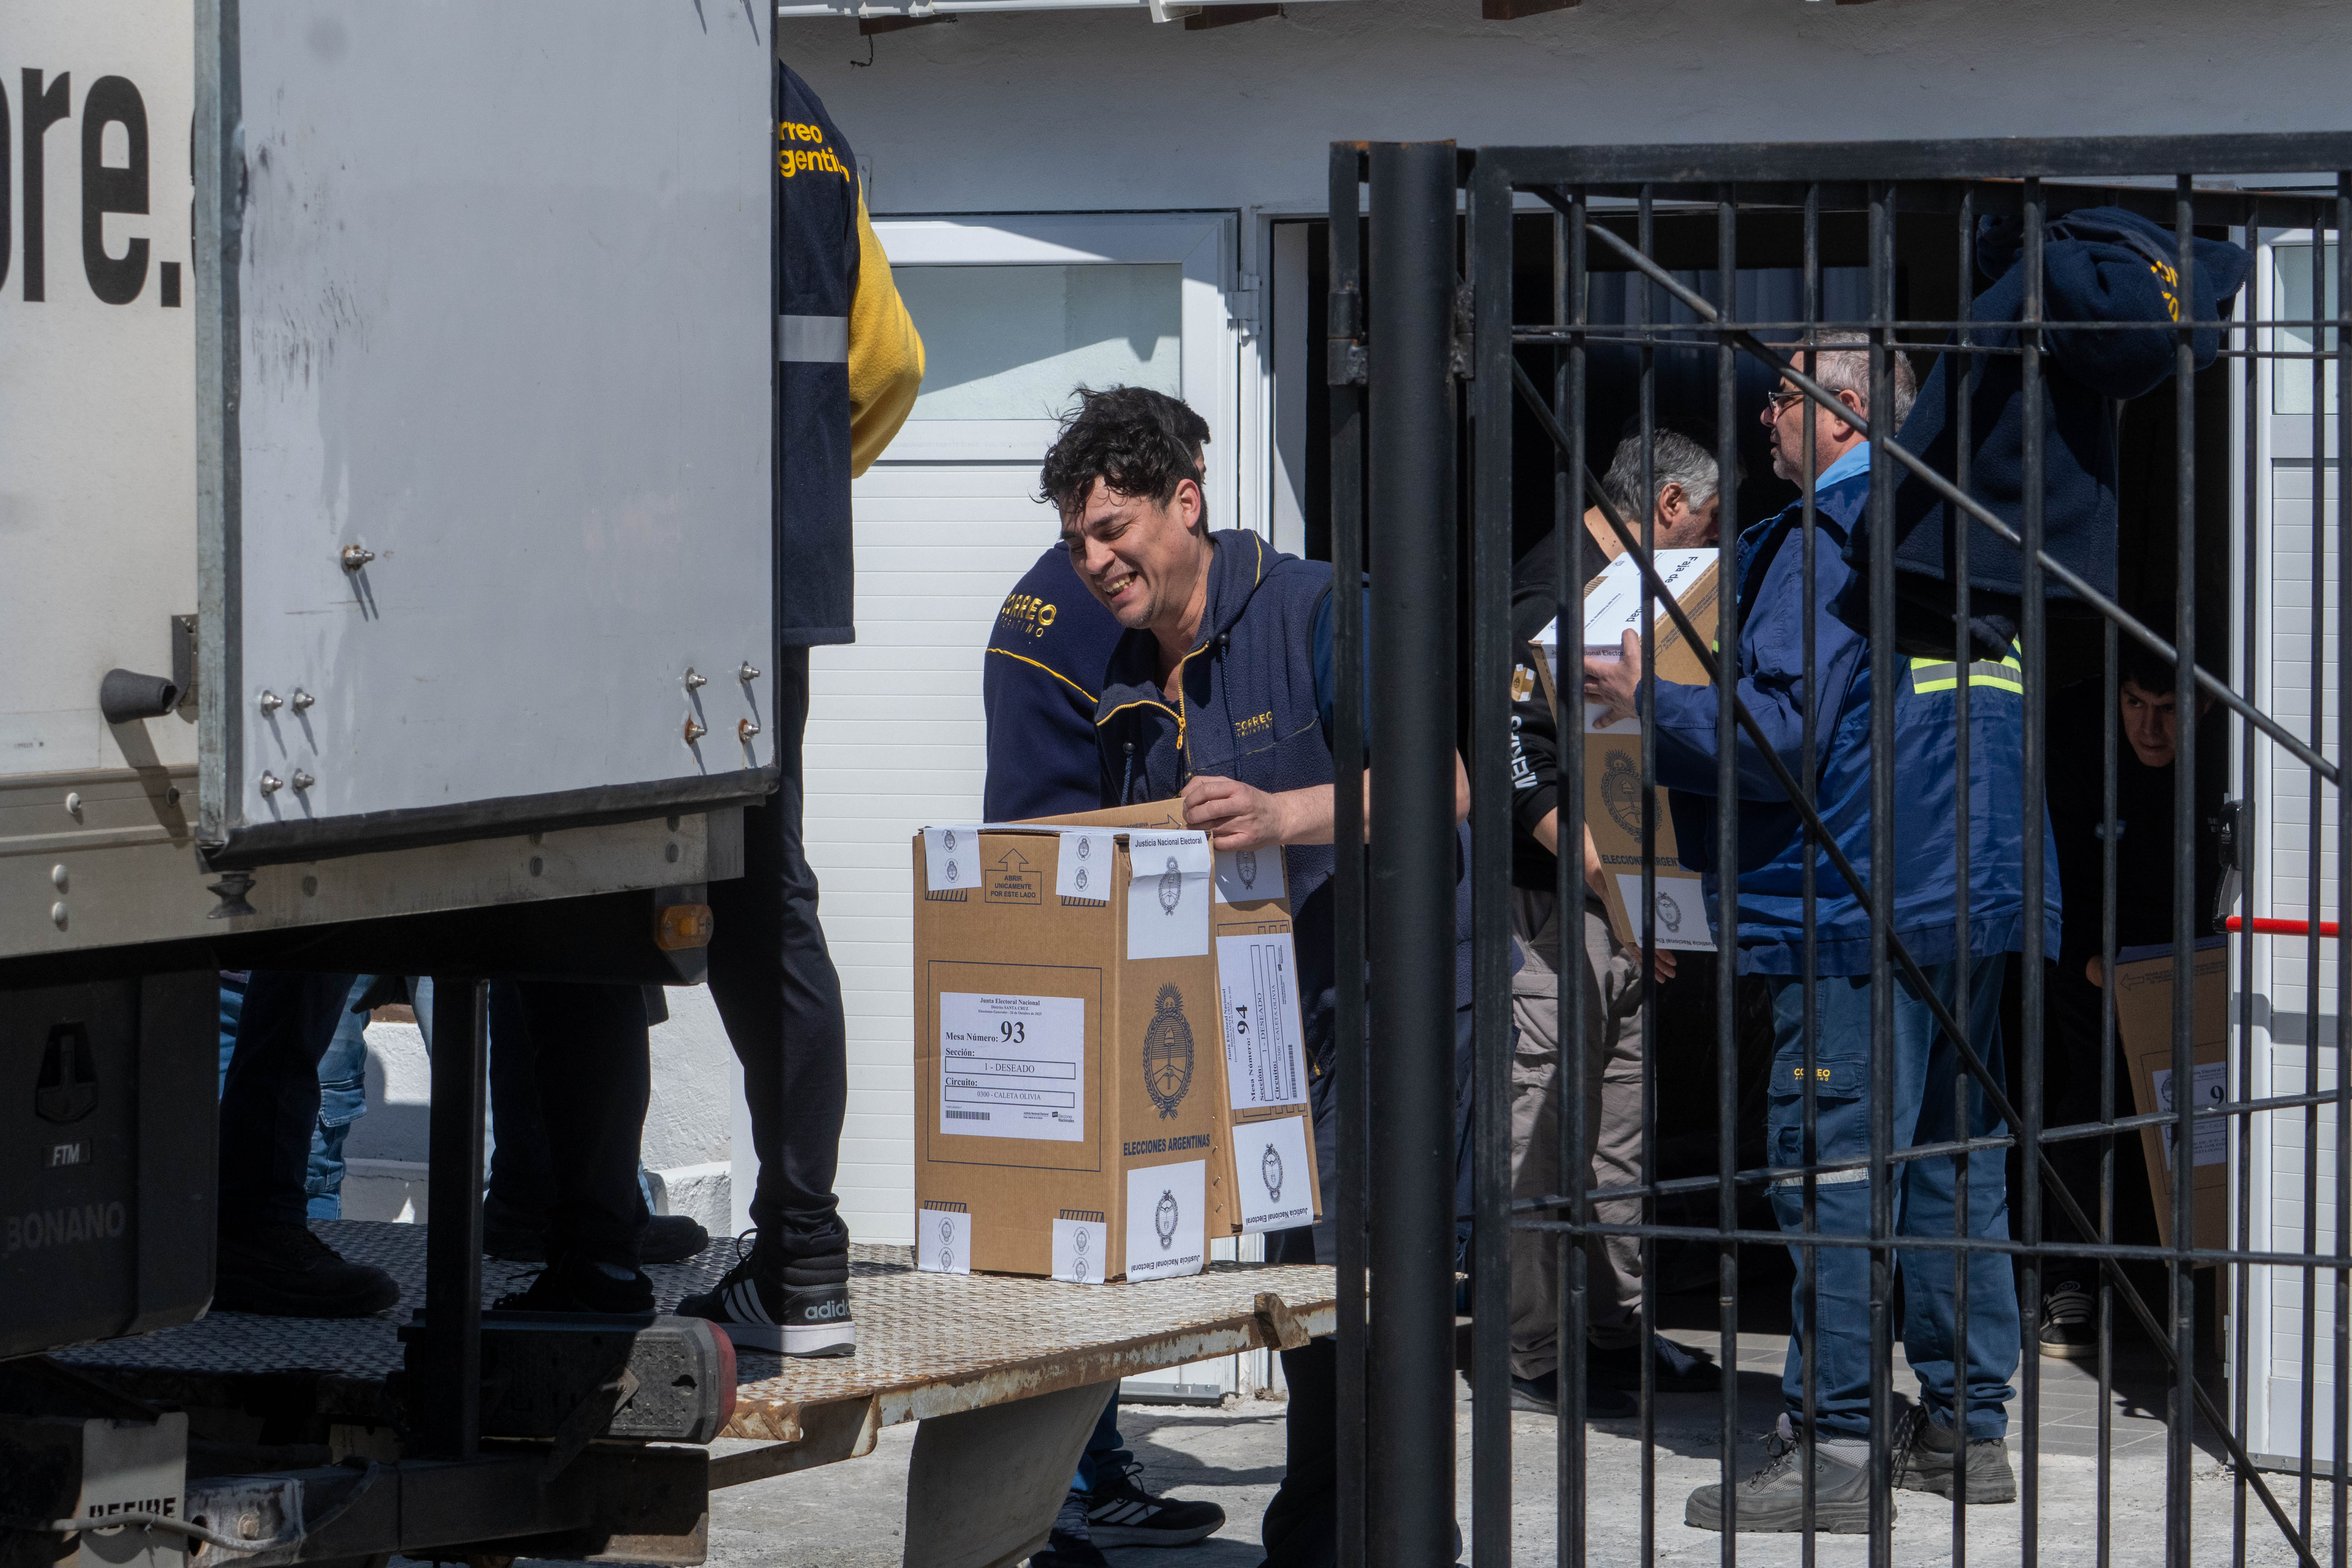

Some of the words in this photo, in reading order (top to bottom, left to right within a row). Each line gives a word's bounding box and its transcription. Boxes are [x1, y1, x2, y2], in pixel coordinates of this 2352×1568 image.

[779, 122, 822, 143] rreo
[0, 67, 181, 308] re.
[1675, 556, 1698, 572] Faja
[1665, 574, 1679, 583] de
[1236, 1005, 1250, 1034] 94
[1258, 993, 1266, 1039] DESEADO
[946, 1032, 964, 1040] Mesa
[966, 1033, 998, 1042] Número:
[1001, 1021, 1025, 1044] 93
[946, 1047, 975, 1056] Sección:
[996, 1063, 1035, 1073] DESEADO
[1794, 1068, 1830, 1077] COEO
[946, 1077, 977, 1086] Circuito:
[1123, 1138, 1166, 1156] ELECCIONES
[1168, 1134, 1210, 1151] ARGENTINAS
[53, 1143, 80, 1166] FTM
[1268, 1211, 1289, 1221] Nacional
[1290, 1208, 1308, 1216] Justicia
[1246, 1215, 1267, 1225] Electoral
[6, 1201, 125, 1251] BONANO
[1156, 1258, 1179, 1269] Nacional
[1180, 1255, 1200, 1263] Justicia
[1131, 1262, 1154, 1272] Electoral
[805, 1299, 850, 1319] adid
